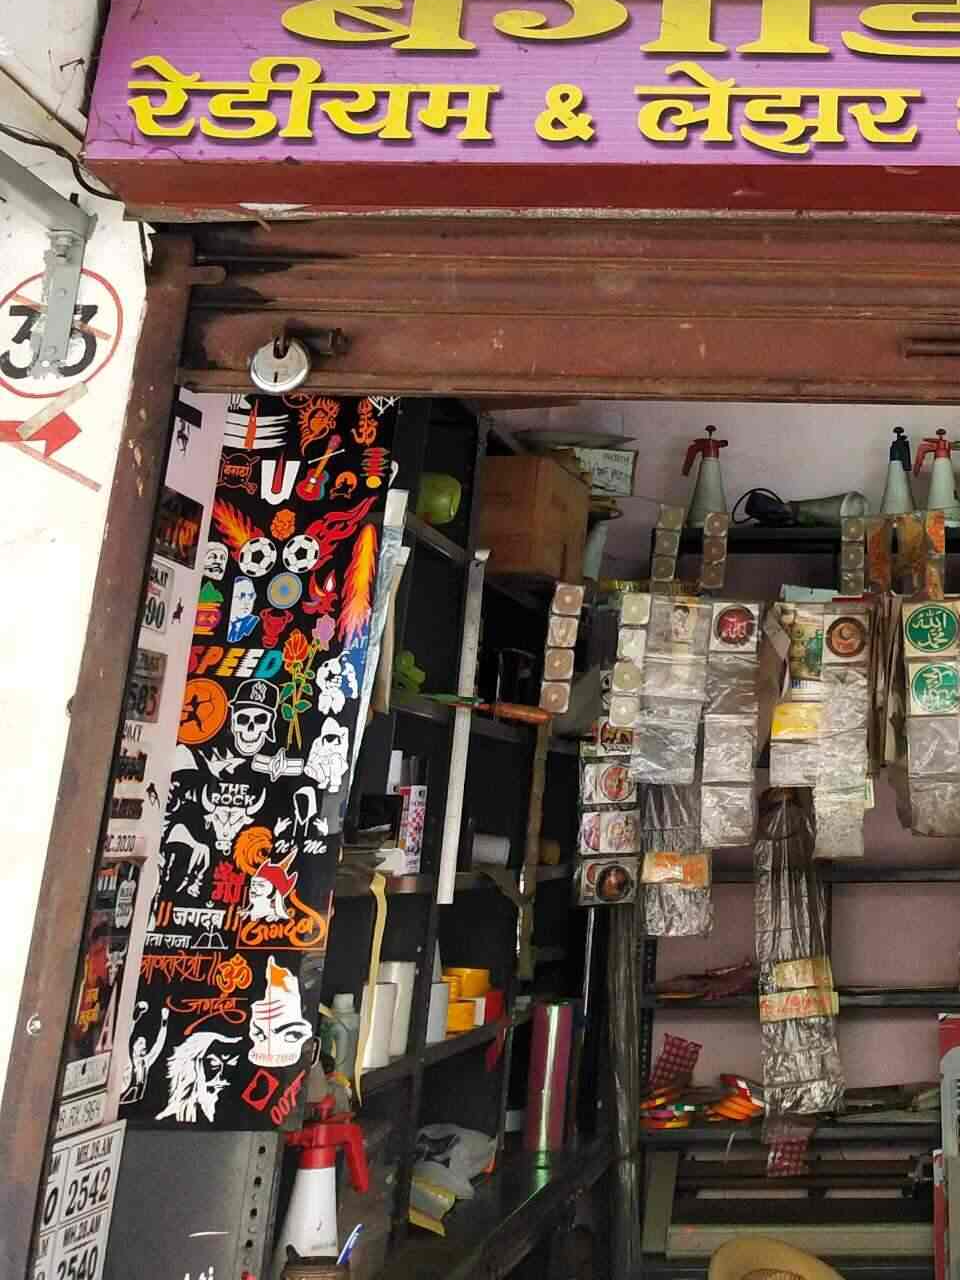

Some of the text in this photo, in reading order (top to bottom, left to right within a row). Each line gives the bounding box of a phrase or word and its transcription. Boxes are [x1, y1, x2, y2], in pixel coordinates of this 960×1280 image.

[127, 55, 501, 141] रेडीयम
[533, 83, 596, 143] &
[633, 62, 922, 154] लेझर
[189, 645, 284, 679] SPEED
[211, 793, 256, 807] ROCK
[218, 783, 250, 794] THE
[303, 839, 327, 855] Me
[65, 1167, 111, 1217] 2542
